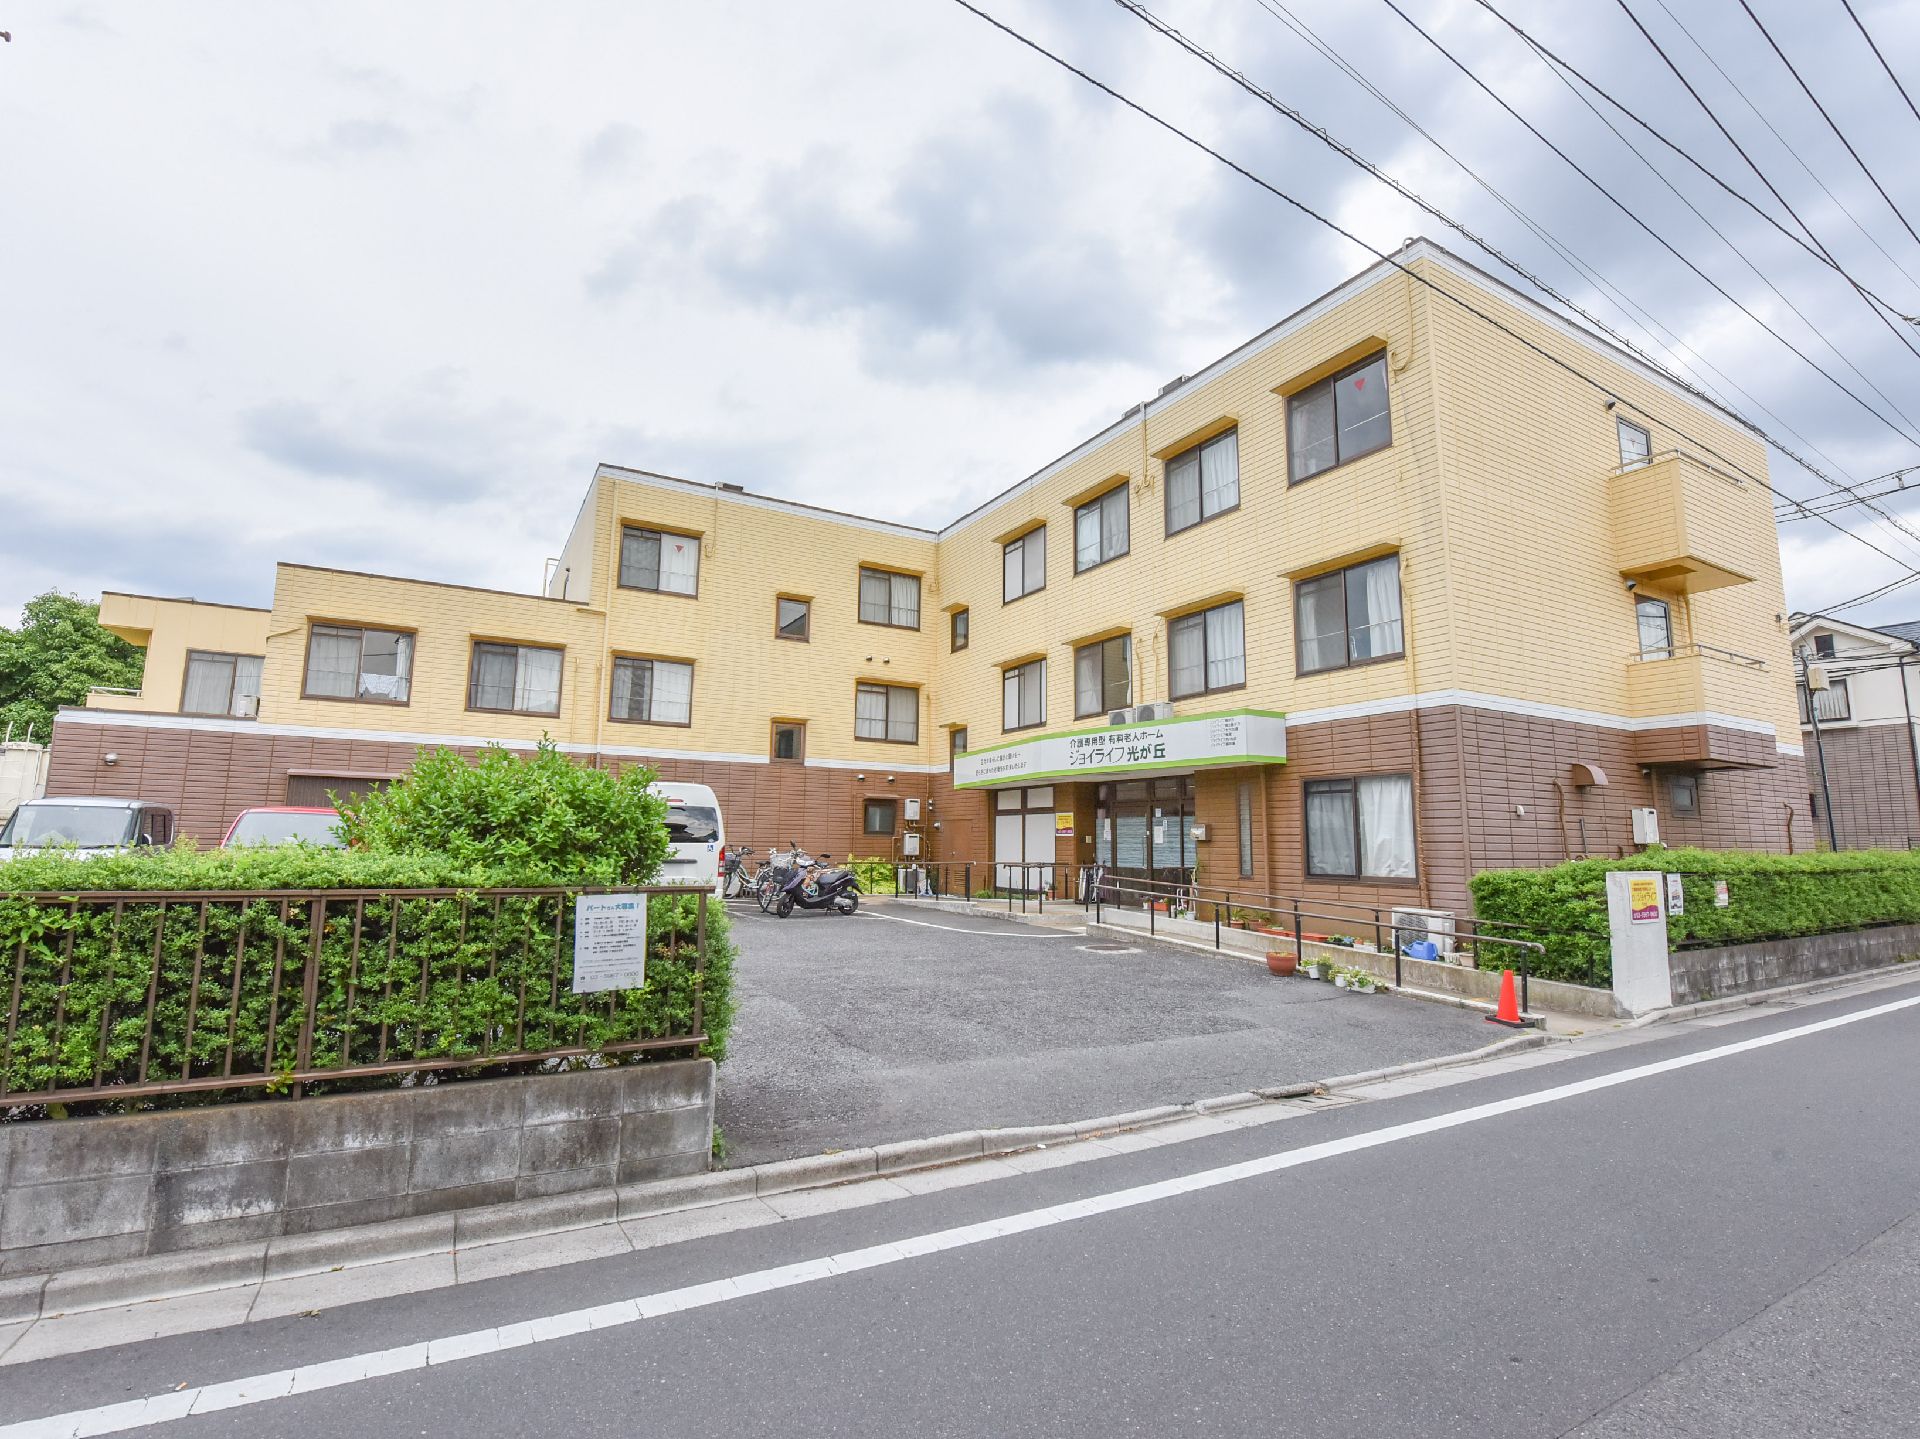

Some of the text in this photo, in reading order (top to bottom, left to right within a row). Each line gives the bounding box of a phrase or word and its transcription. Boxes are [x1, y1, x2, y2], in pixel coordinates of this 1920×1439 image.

[1070, 729, 1164, 749] 介護専用型 有料老人ホーム
